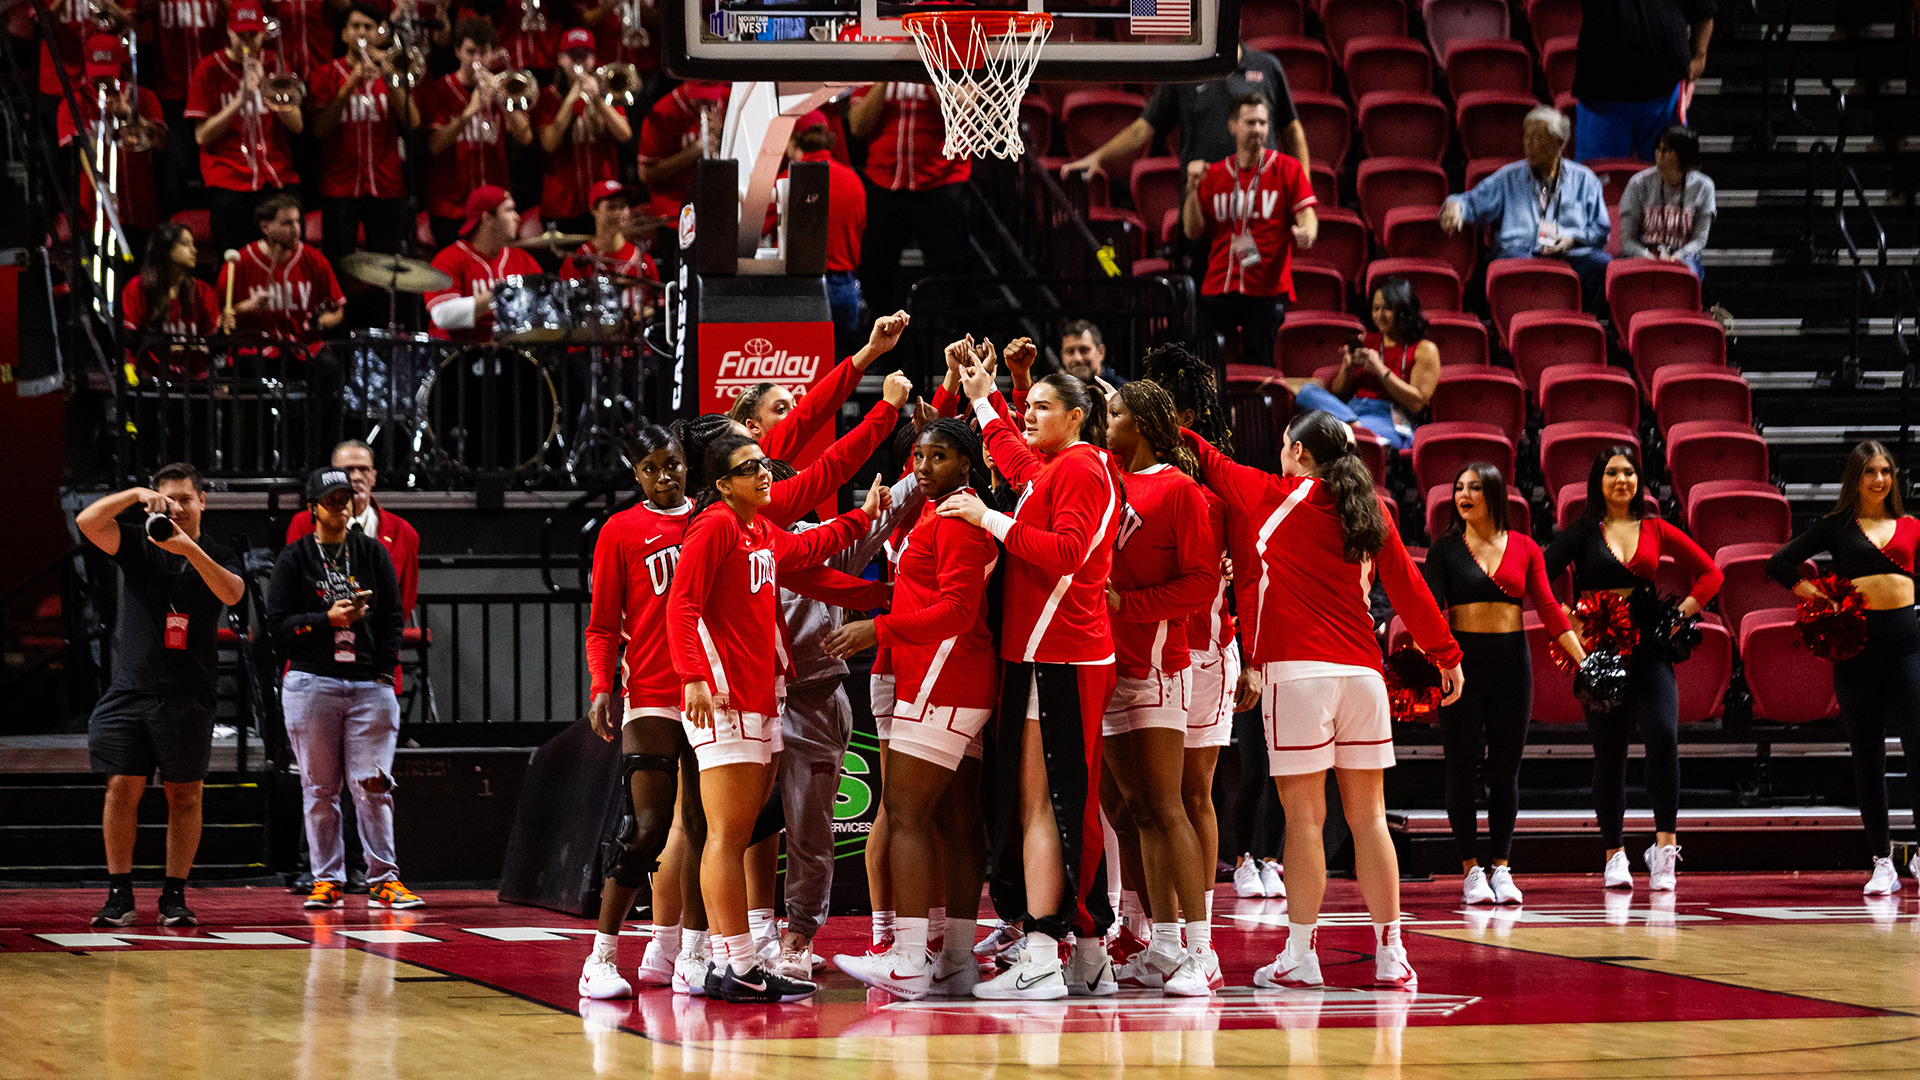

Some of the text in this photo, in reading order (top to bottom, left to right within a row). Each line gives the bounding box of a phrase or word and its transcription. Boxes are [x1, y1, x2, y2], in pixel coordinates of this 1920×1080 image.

[738, 15, 769, 23] MOUNTAIN
[738, 22, 769, 33] WEST
[716, 350, 820, 384] Findlay
[714, 384, 808, 399] TOTA
